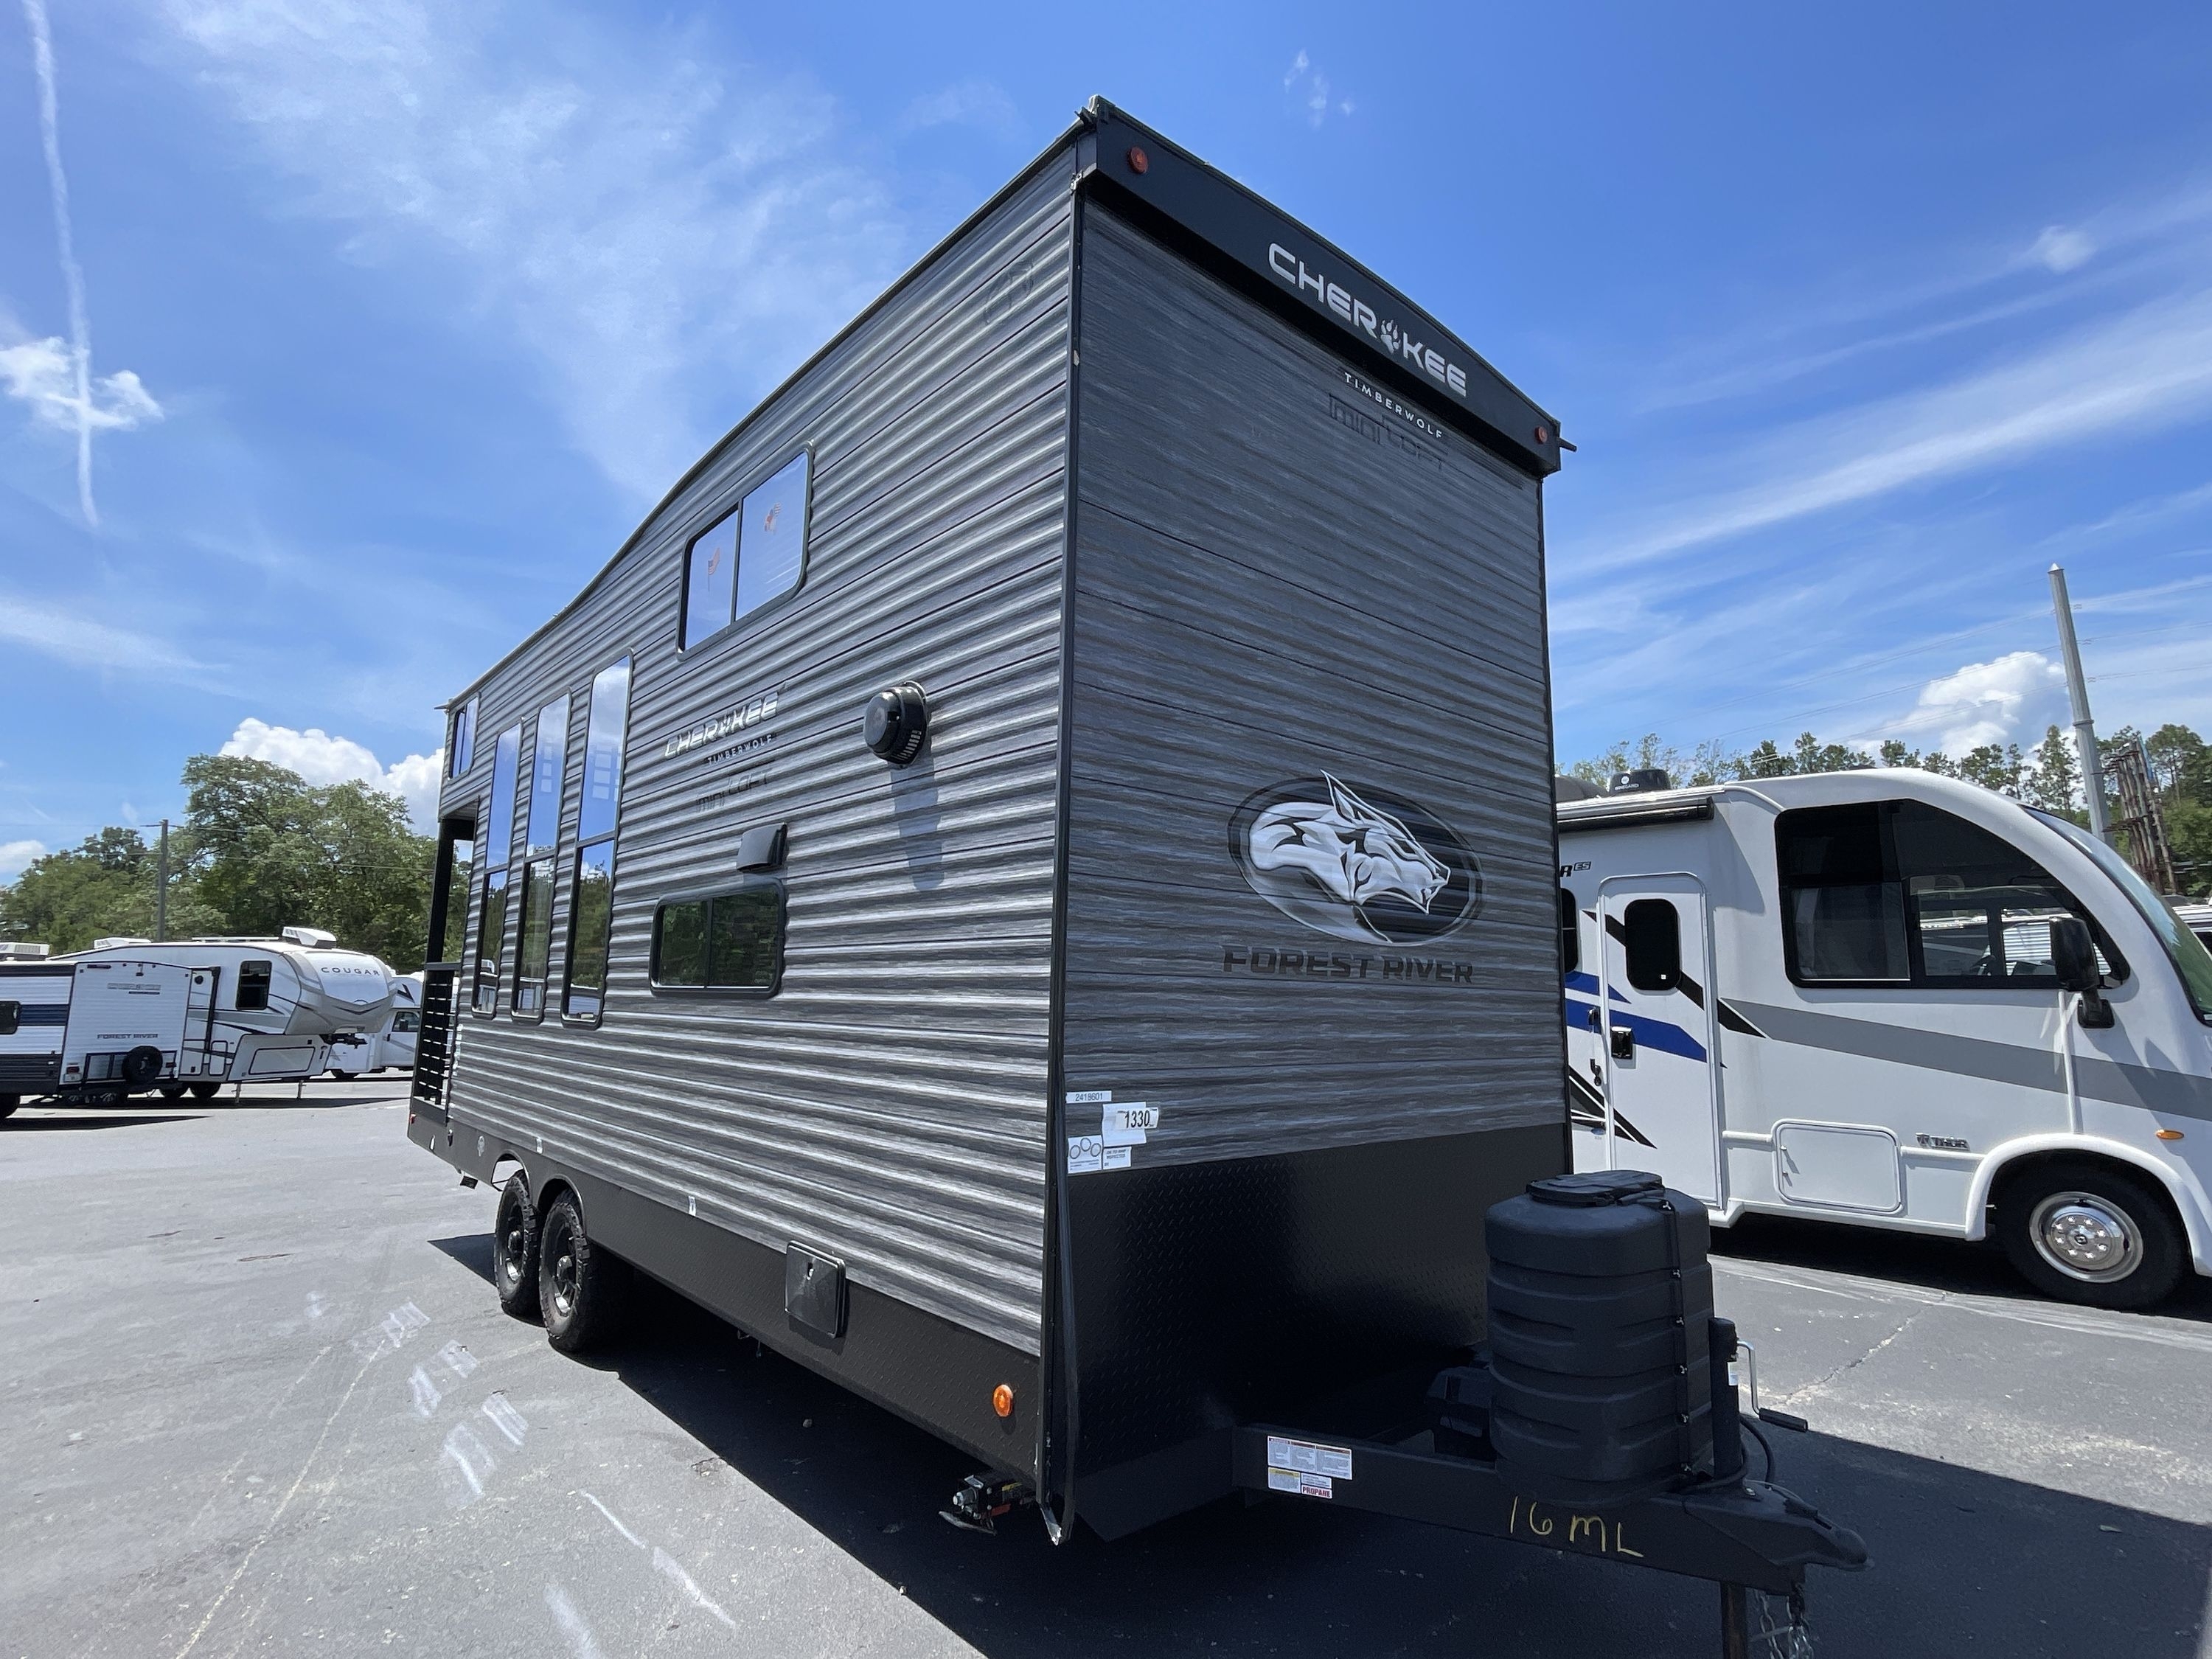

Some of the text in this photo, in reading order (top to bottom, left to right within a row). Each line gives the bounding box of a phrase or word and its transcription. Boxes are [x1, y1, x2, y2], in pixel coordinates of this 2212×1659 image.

[1268, 243, 1467, 397] CHEROKEE
[1344, 371, 1443, 439] TIMBERWOLF
[706, 734, 773, 765] TIMBERWOLF
[321, 967, 380, 976] COUGAR
[1221, 945, 1474, 984] FOREST RIVER
[1075, 1092, 1103, 1102] 2418601
[1124, 1110, 1150, 1128] 1330
[1302, 1486, 1331, 1498] PROPANE
